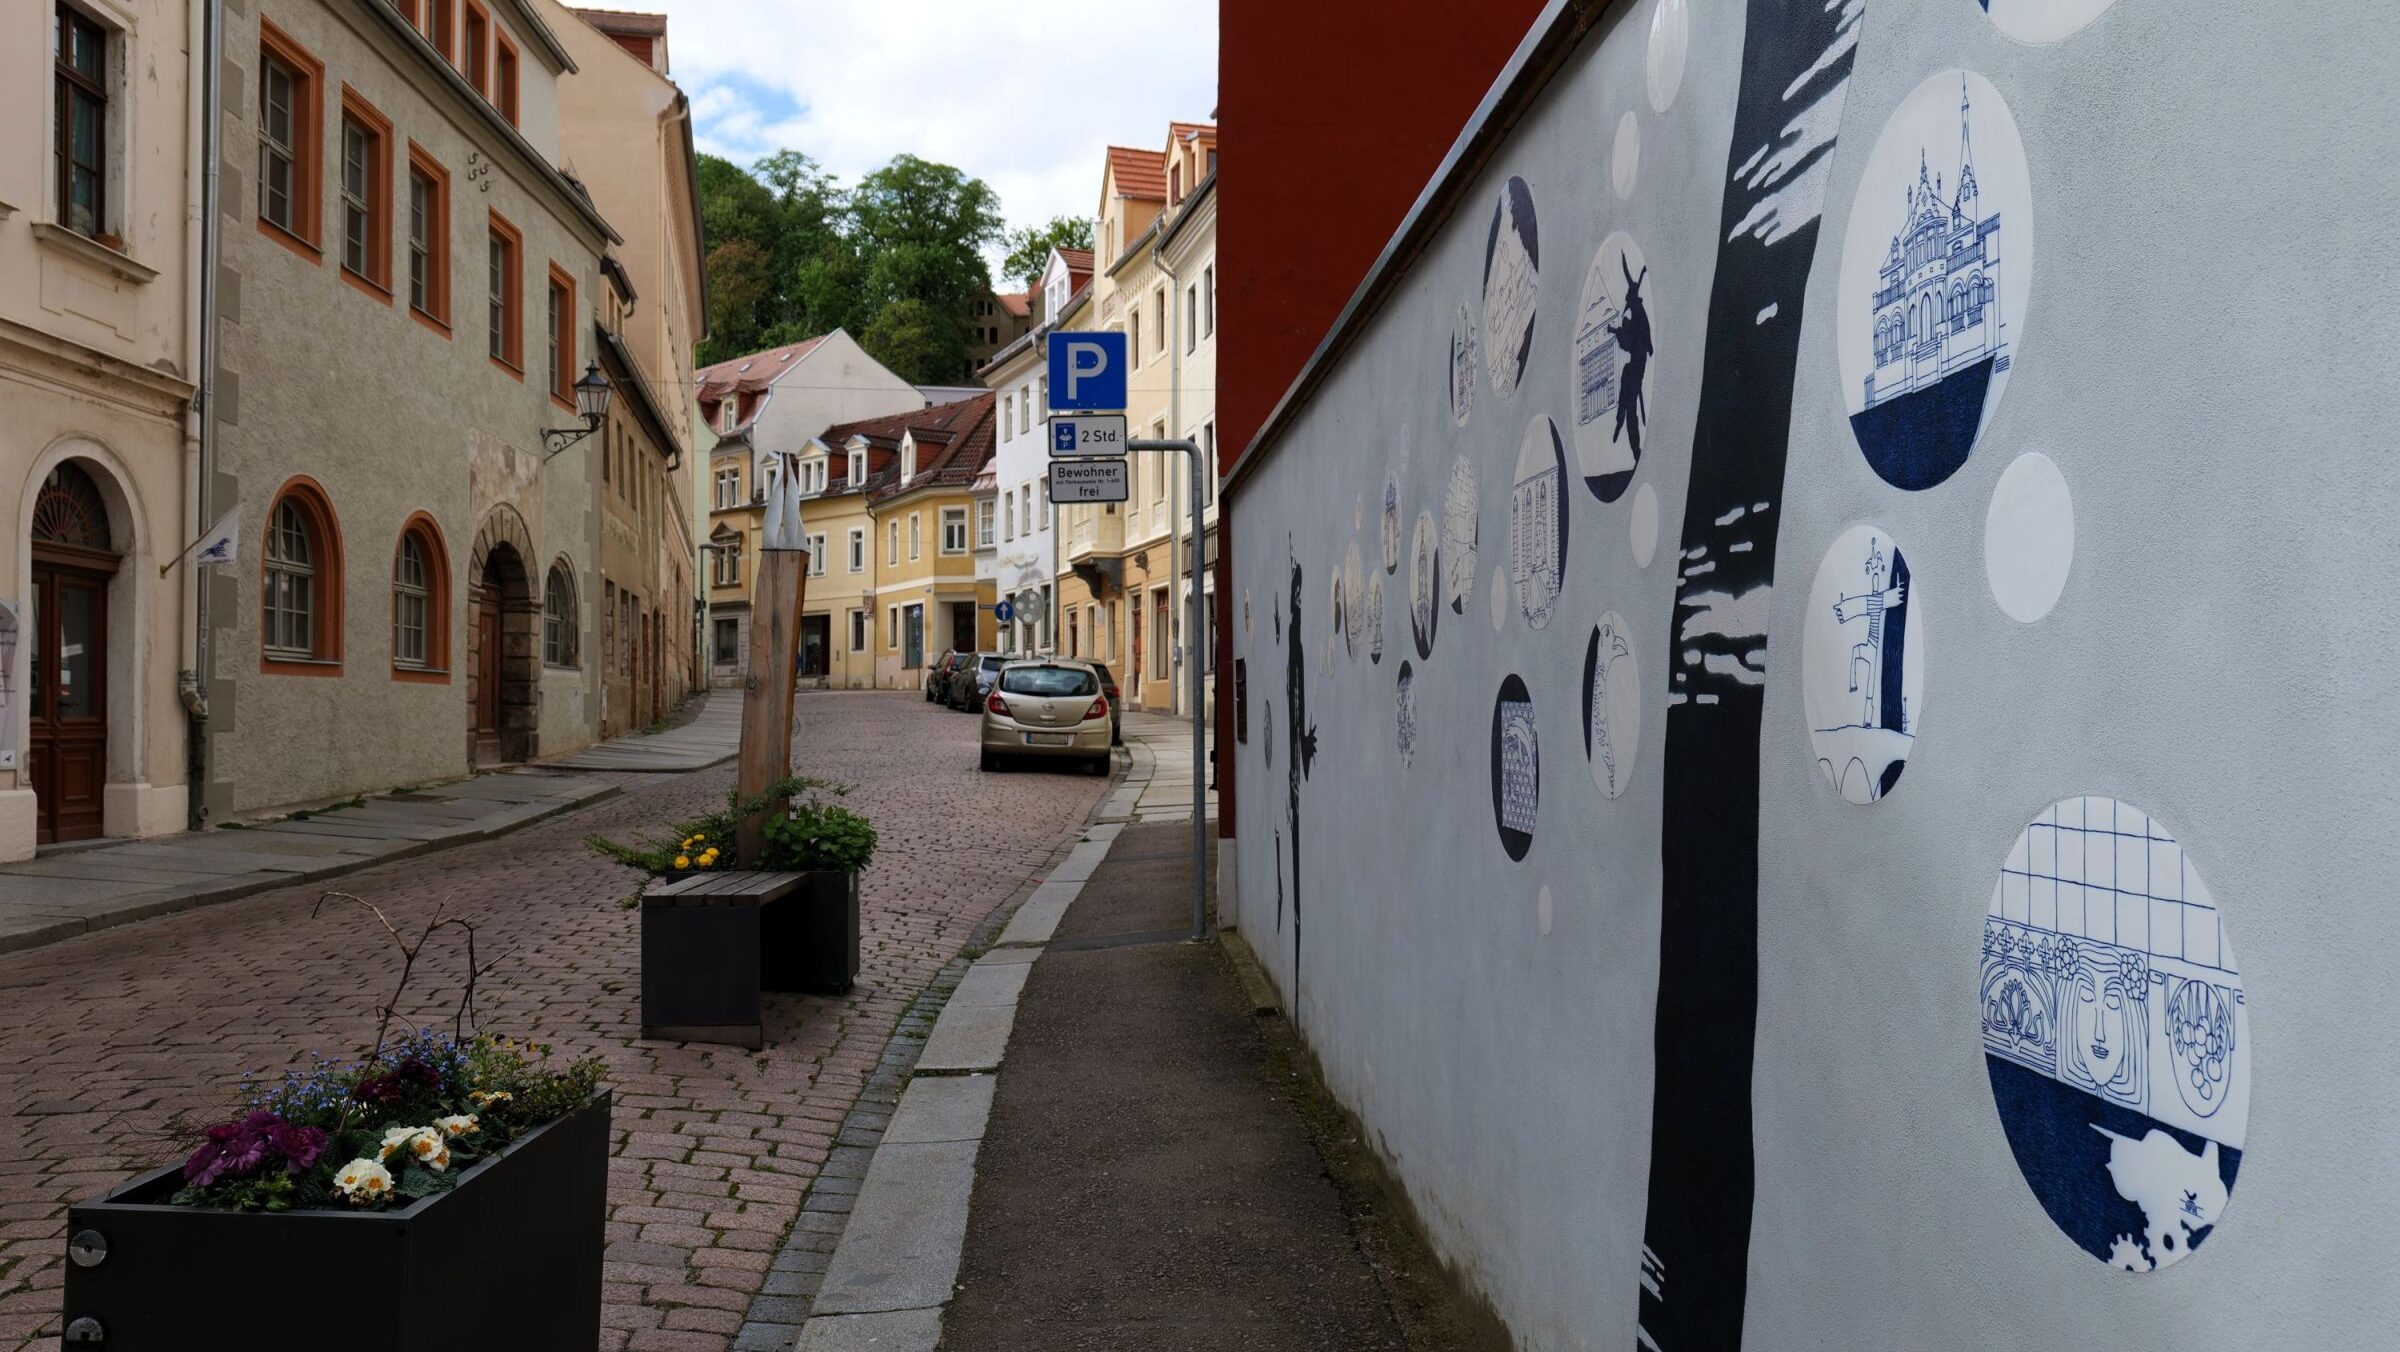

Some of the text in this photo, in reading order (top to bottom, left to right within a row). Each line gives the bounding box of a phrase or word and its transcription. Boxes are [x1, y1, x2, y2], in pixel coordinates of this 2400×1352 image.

[1067, 342, 1108, 400] P
[1082, 430, 1119, 443] 2 Std.
[1058, 466, 1118, 478] Bewohner
[1079, 486, 1099, 497] frei
